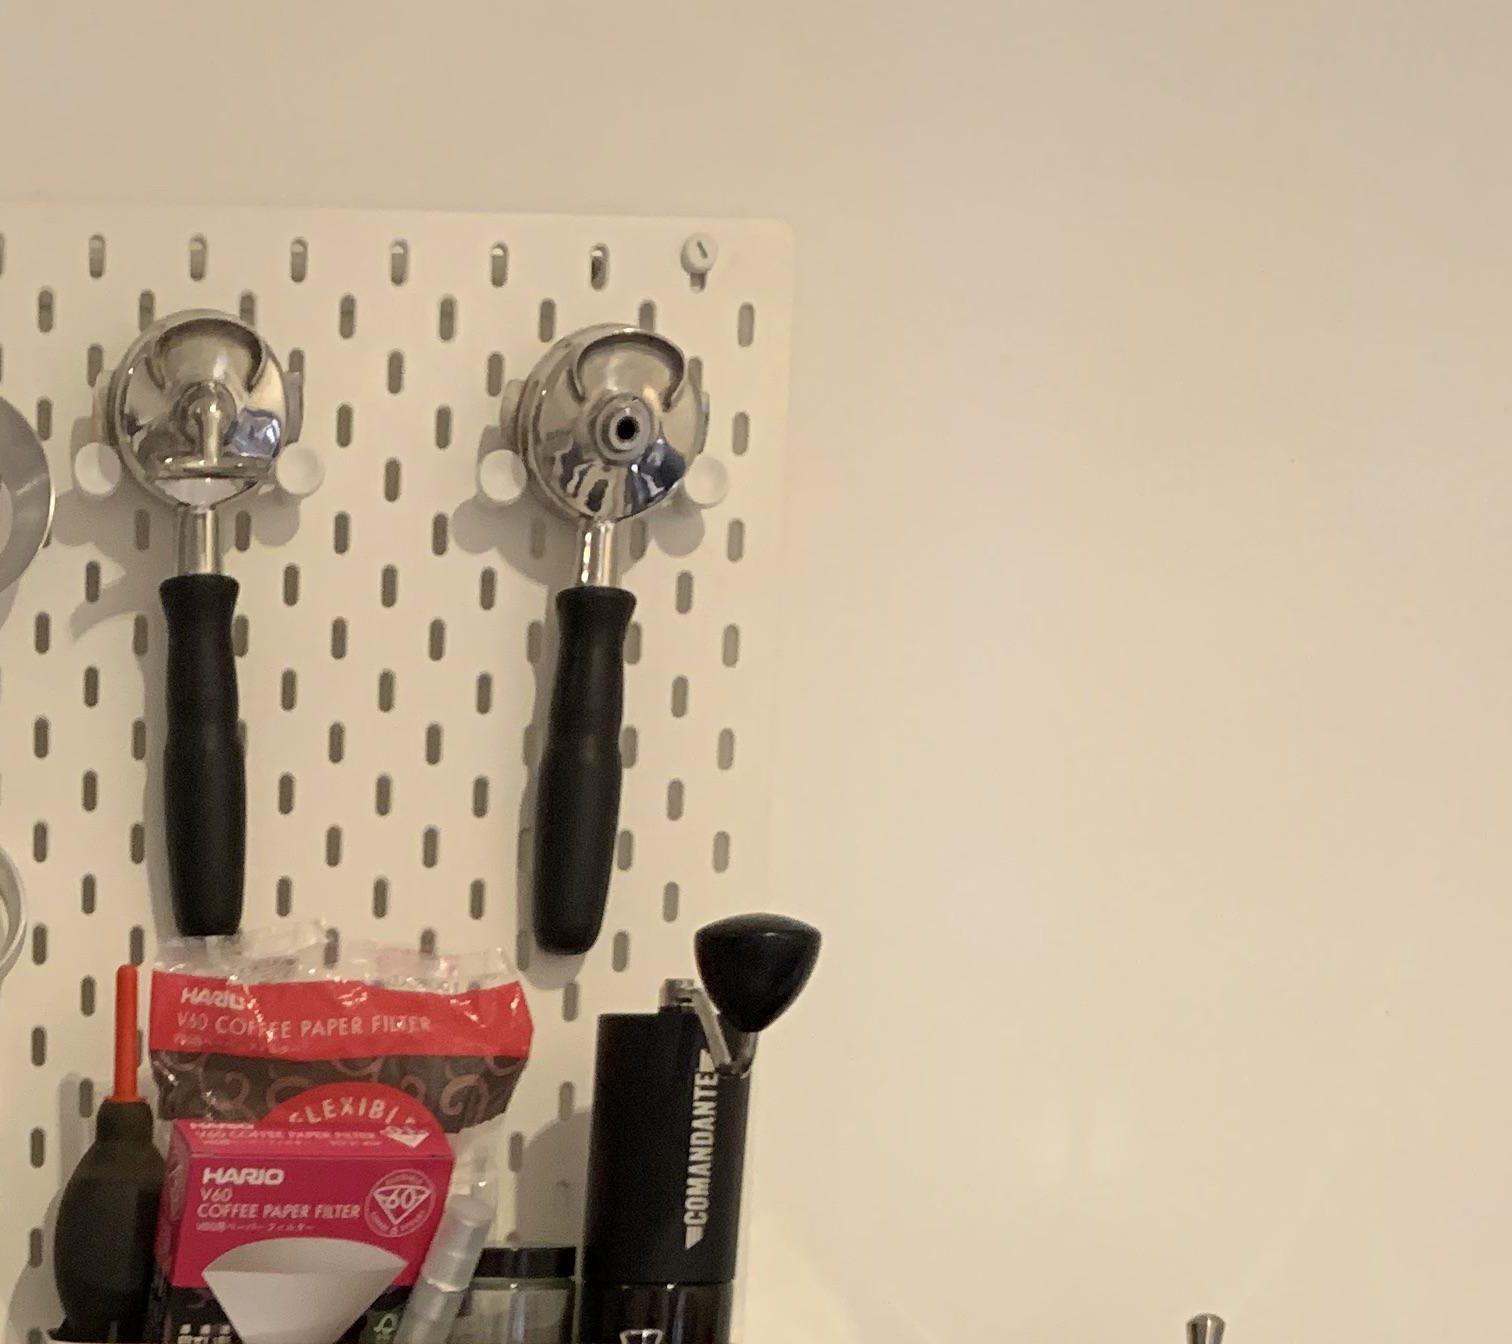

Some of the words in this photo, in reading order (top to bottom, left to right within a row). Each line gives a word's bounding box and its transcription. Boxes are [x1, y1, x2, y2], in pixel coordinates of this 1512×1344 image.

[215, 1014, 292, 1039] COFFEE
[300, 1017, 363, 1037] PAPER
[371, 1015, 432, 1034] FILTER
[683, 1072, 719, 1226] COMANDANTE
[202, 1167, 286, 1186] HARIO
[200, 1186, 233, 1203] V60
[196, 1203, 259, 1219] COFFEE
[262, 1203, 312, 1219] PAPER
[314, 1204, 362, 1219] FILTER
